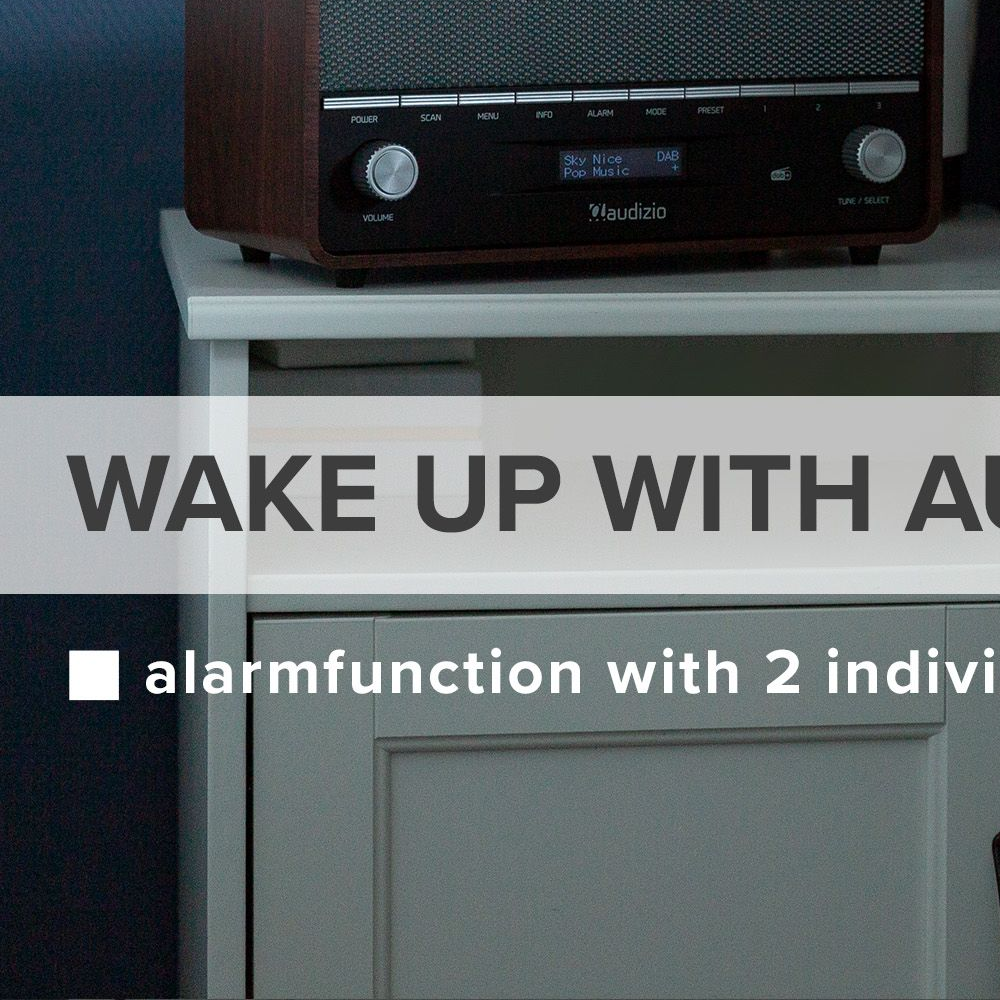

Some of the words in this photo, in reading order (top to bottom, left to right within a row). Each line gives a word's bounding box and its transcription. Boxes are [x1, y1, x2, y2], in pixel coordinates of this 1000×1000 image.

[645, 107, 667, 116] MODE
[697, 106, 724, 115] PRESET
[815, 103, 822, 112] 2
[420, 113, 442, 122] SCAN
[477, 112, 499, 121] MENU
[535, 110, 553, 119] INFO
[587, 109, 614, 118] ALARM
[350, 115, 378, 124] POWER
[563, 154, 586, 167] Sky
[592, 153, 622, 165] Nice
[657, 150, 680, 162] DAB
[564, 167, 586, 178] Pop
[592, 165, 630, 177] Music
[606, 202, 667, 221] audizio
[362, 213, 394, 222] VOLUME
